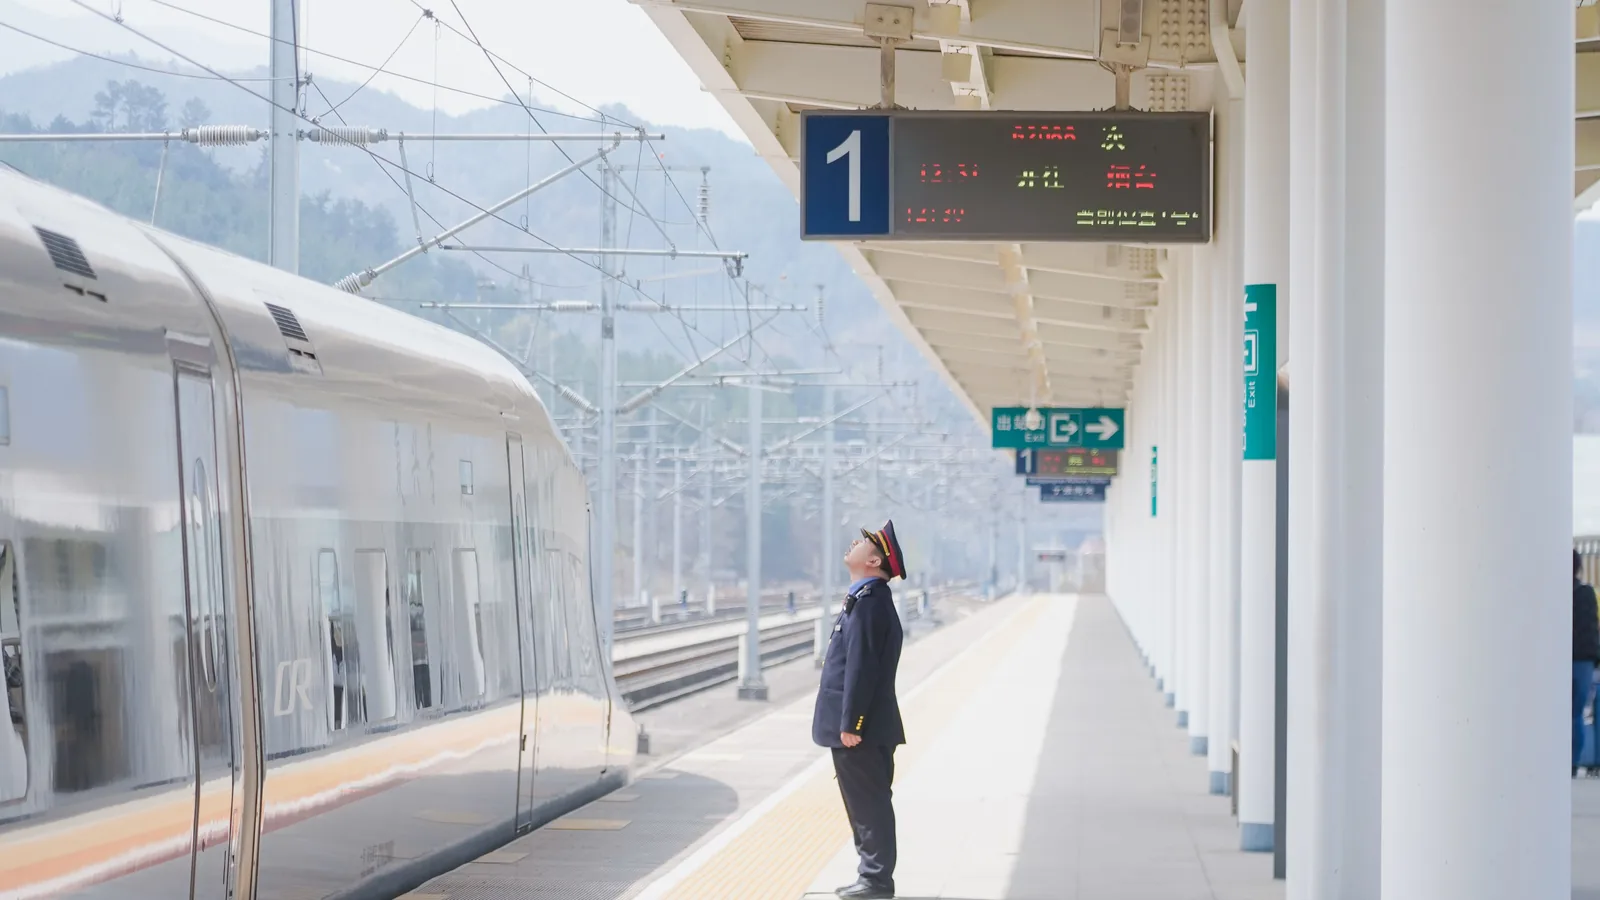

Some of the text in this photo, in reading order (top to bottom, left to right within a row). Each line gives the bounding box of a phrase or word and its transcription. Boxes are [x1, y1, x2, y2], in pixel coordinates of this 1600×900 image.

[1101, 125, 1126, 151] 次
[826, 130, 862, 222] 1
[1248, 381, 1256, 408] Exit
[1025, 431, 1045, 443] Exit
[1020, 449, 1032, 473] 1
[274, 658, 314, 717] CR
